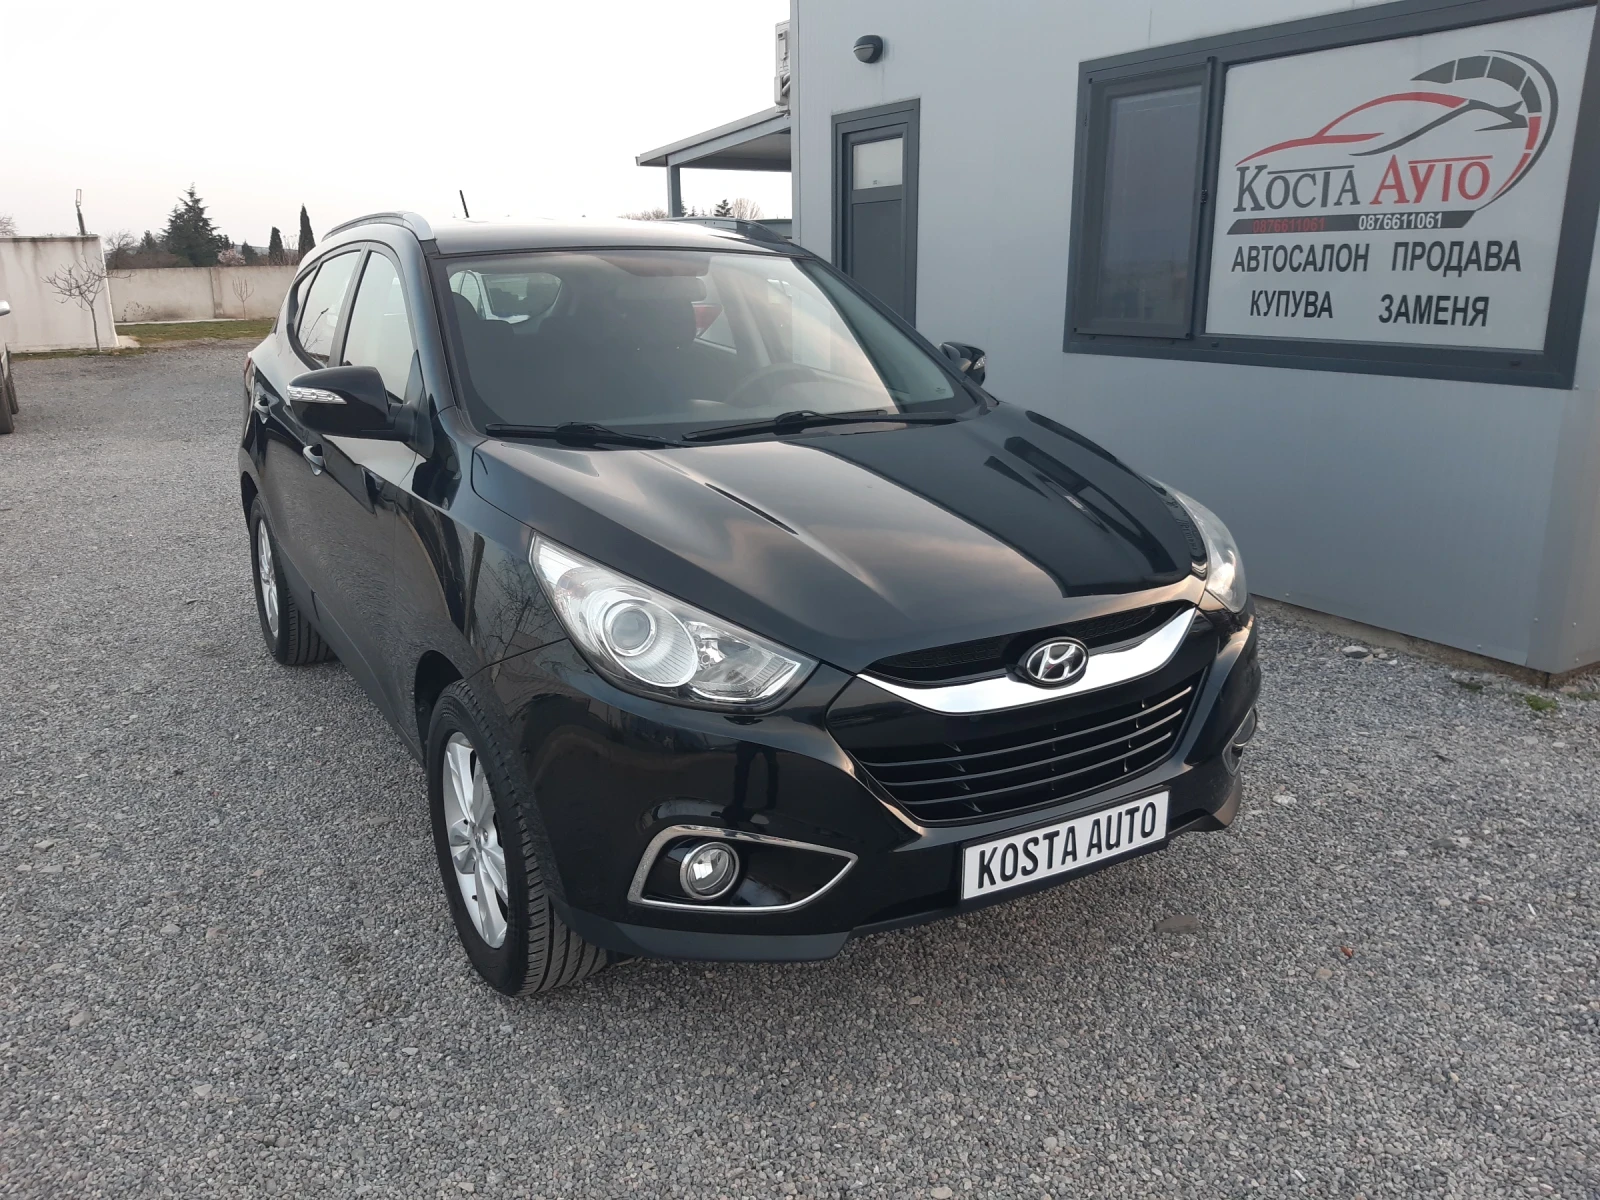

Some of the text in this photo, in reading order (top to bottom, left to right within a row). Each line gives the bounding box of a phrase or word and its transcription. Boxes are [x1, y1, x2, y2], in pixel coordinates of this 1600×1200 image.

[1252, 212, 1443, 233] 0876611061 0876611061
[1231, 240, 1522, 277] АВТОСАЛОН ПРОДАВА
[1250, 290, 1490, 327] КУПУВА ЗАМЕНЯ
[977, 801, 1157, 889] KOSTA AUTO
